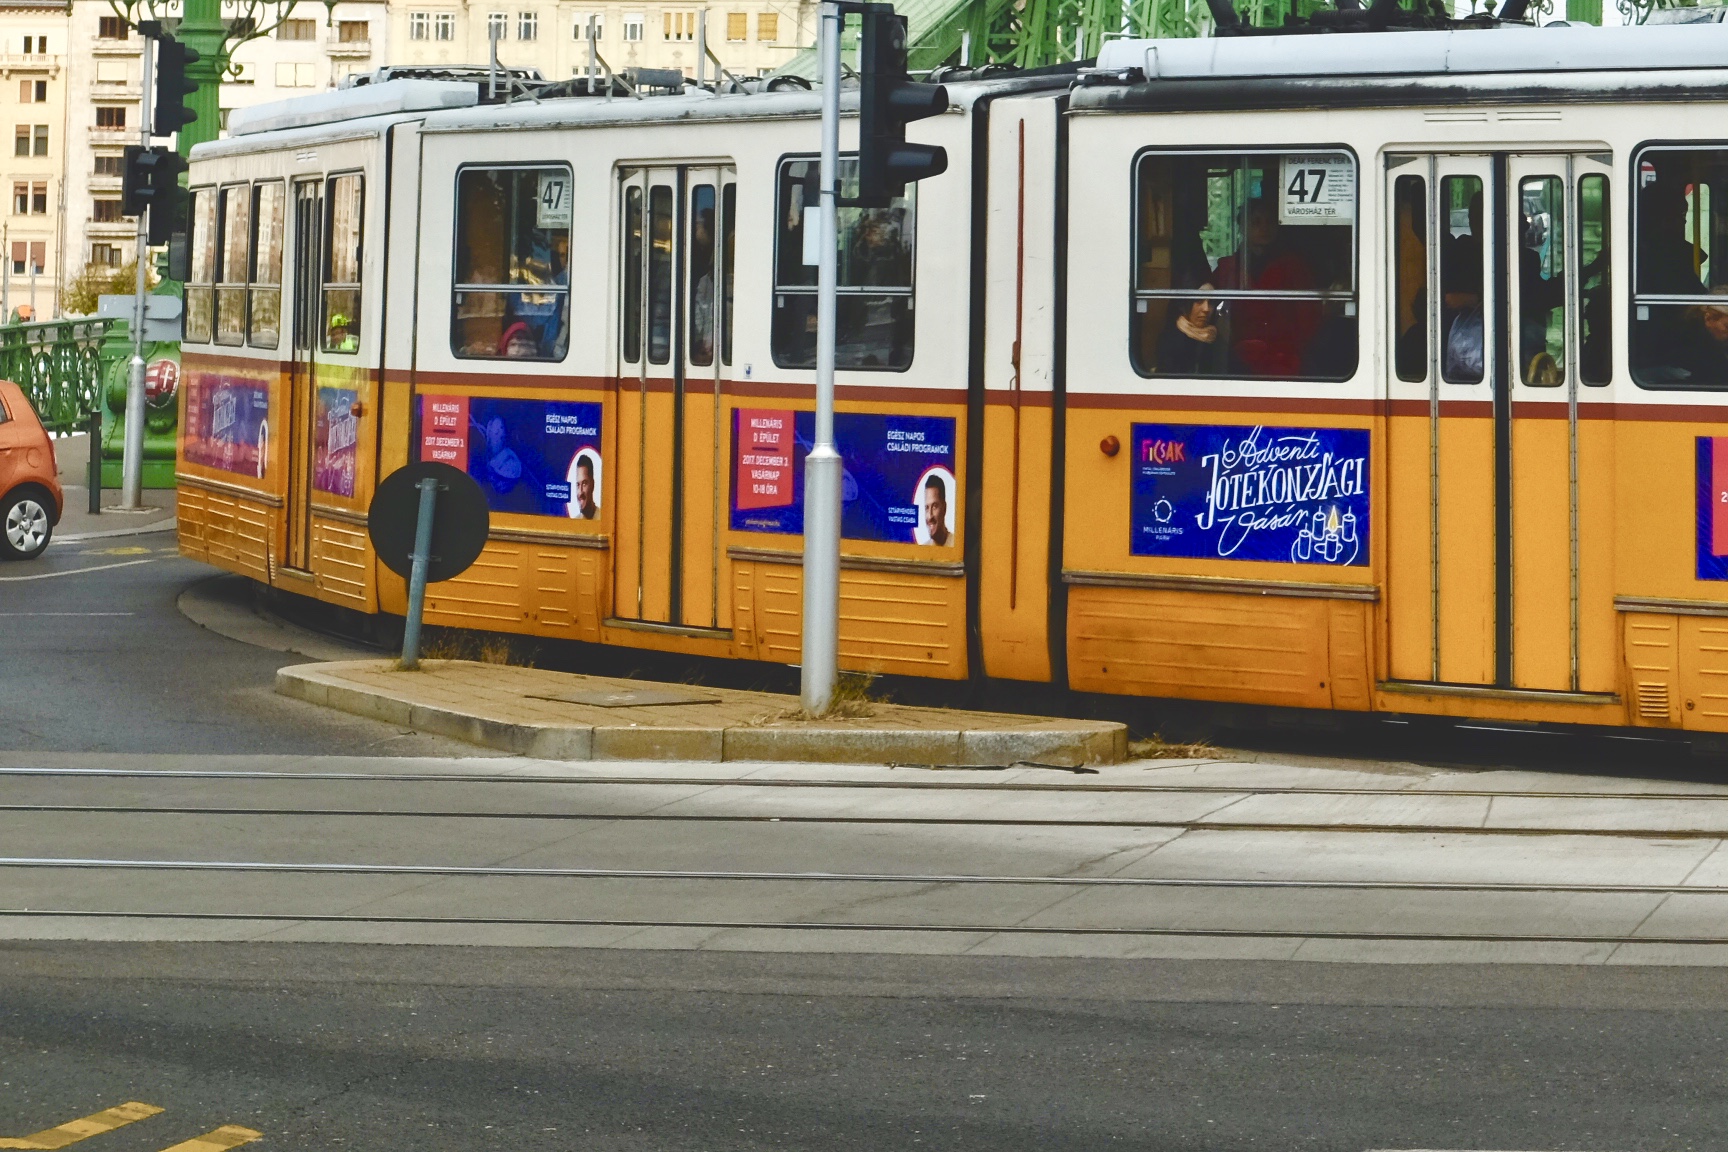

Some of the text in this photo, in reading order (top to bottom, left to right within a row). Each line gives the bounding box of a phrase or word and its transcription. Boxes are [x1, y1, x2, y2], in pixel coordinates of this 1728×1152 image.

[542, 181, 563, 209] 47
[1287, 169, 1326, 203] 47
[1222, 425, 1321, 469] Adventi
[1195, 452, 1365, 530] JÓTÉKONYSÁGI
